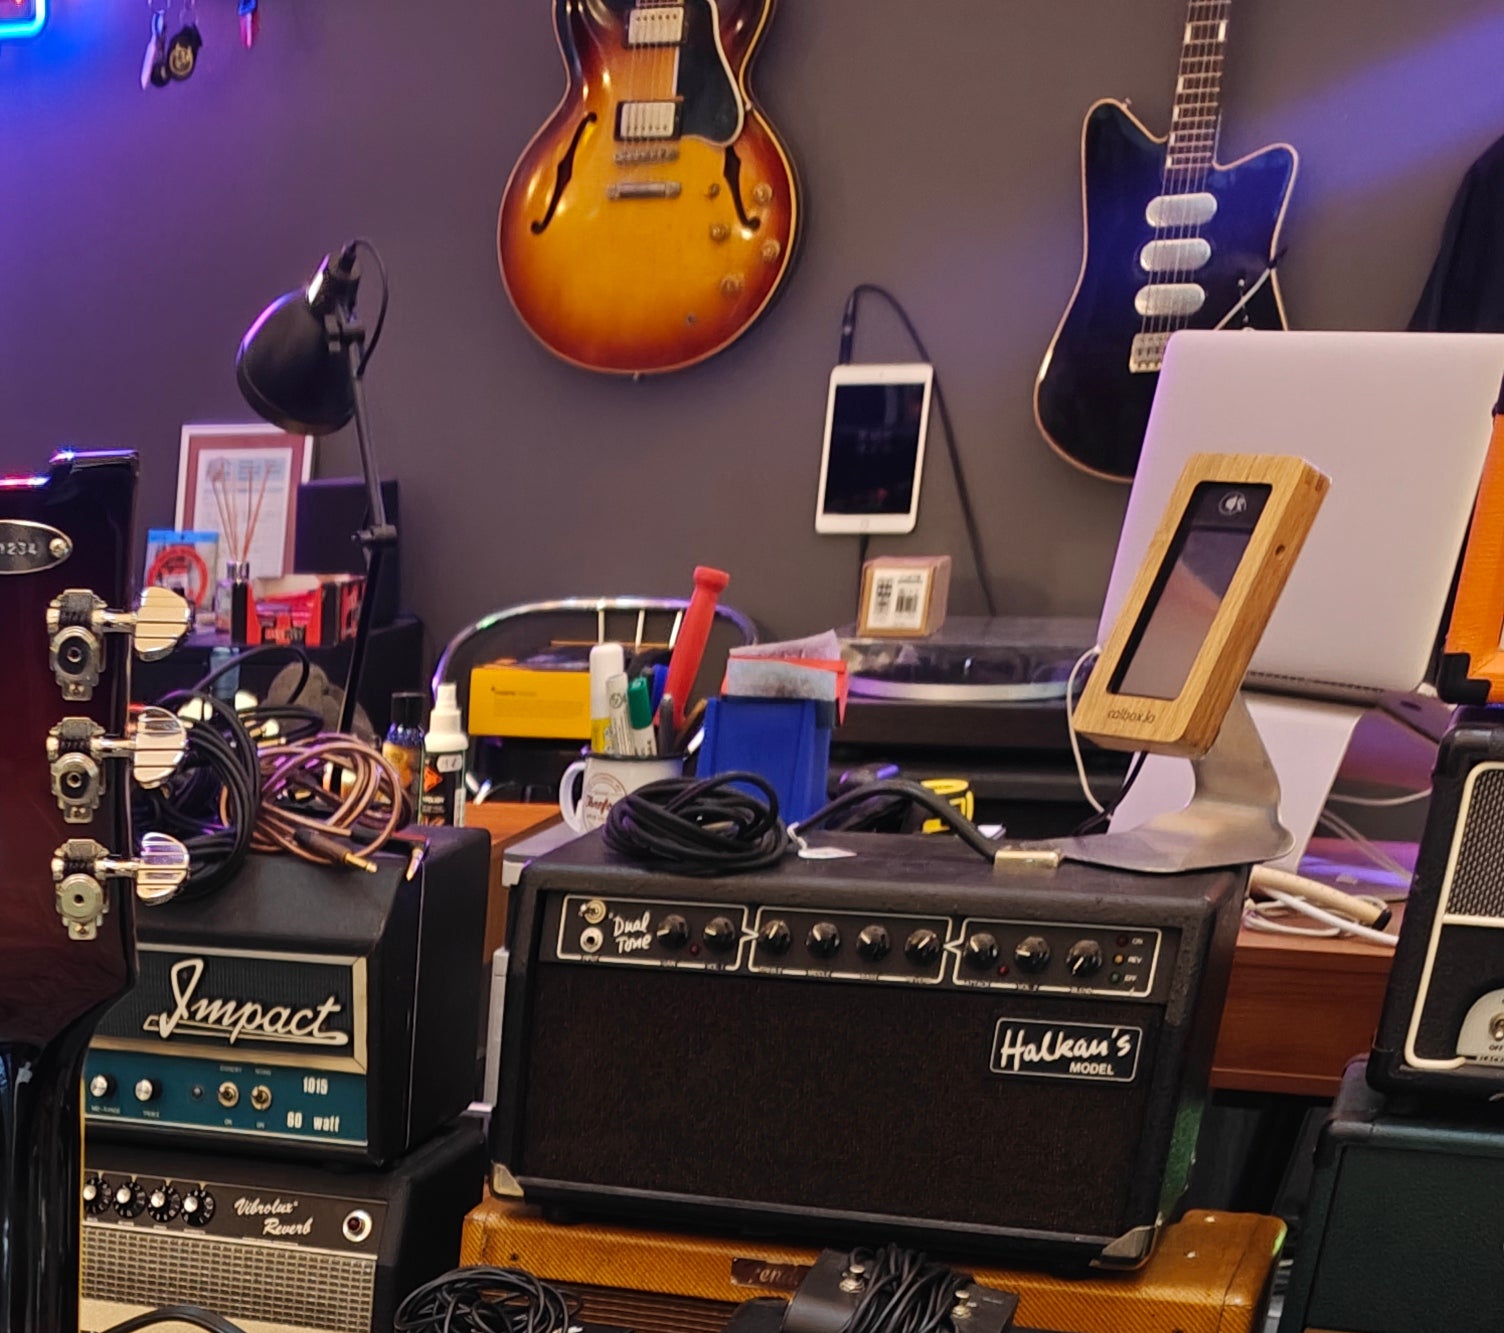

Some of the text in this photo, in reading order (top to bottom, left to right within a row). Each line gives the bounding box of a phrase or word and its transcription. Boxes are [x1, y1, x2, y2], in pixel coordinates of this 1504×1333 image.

[613, 911, 650, 937] Dual
[615, 935, 652, 954] Tone
[143, 958, 348, 1045] Impact
[1000, 1027, 1131, 1071] Halkan's
[1069, 1061, 1114, 1075] MODEL
[303, 1076, 328, 1095] 1015
[313, 1115, 340, 1132] watt
[262, 1216, 314, 1235] Reverb
